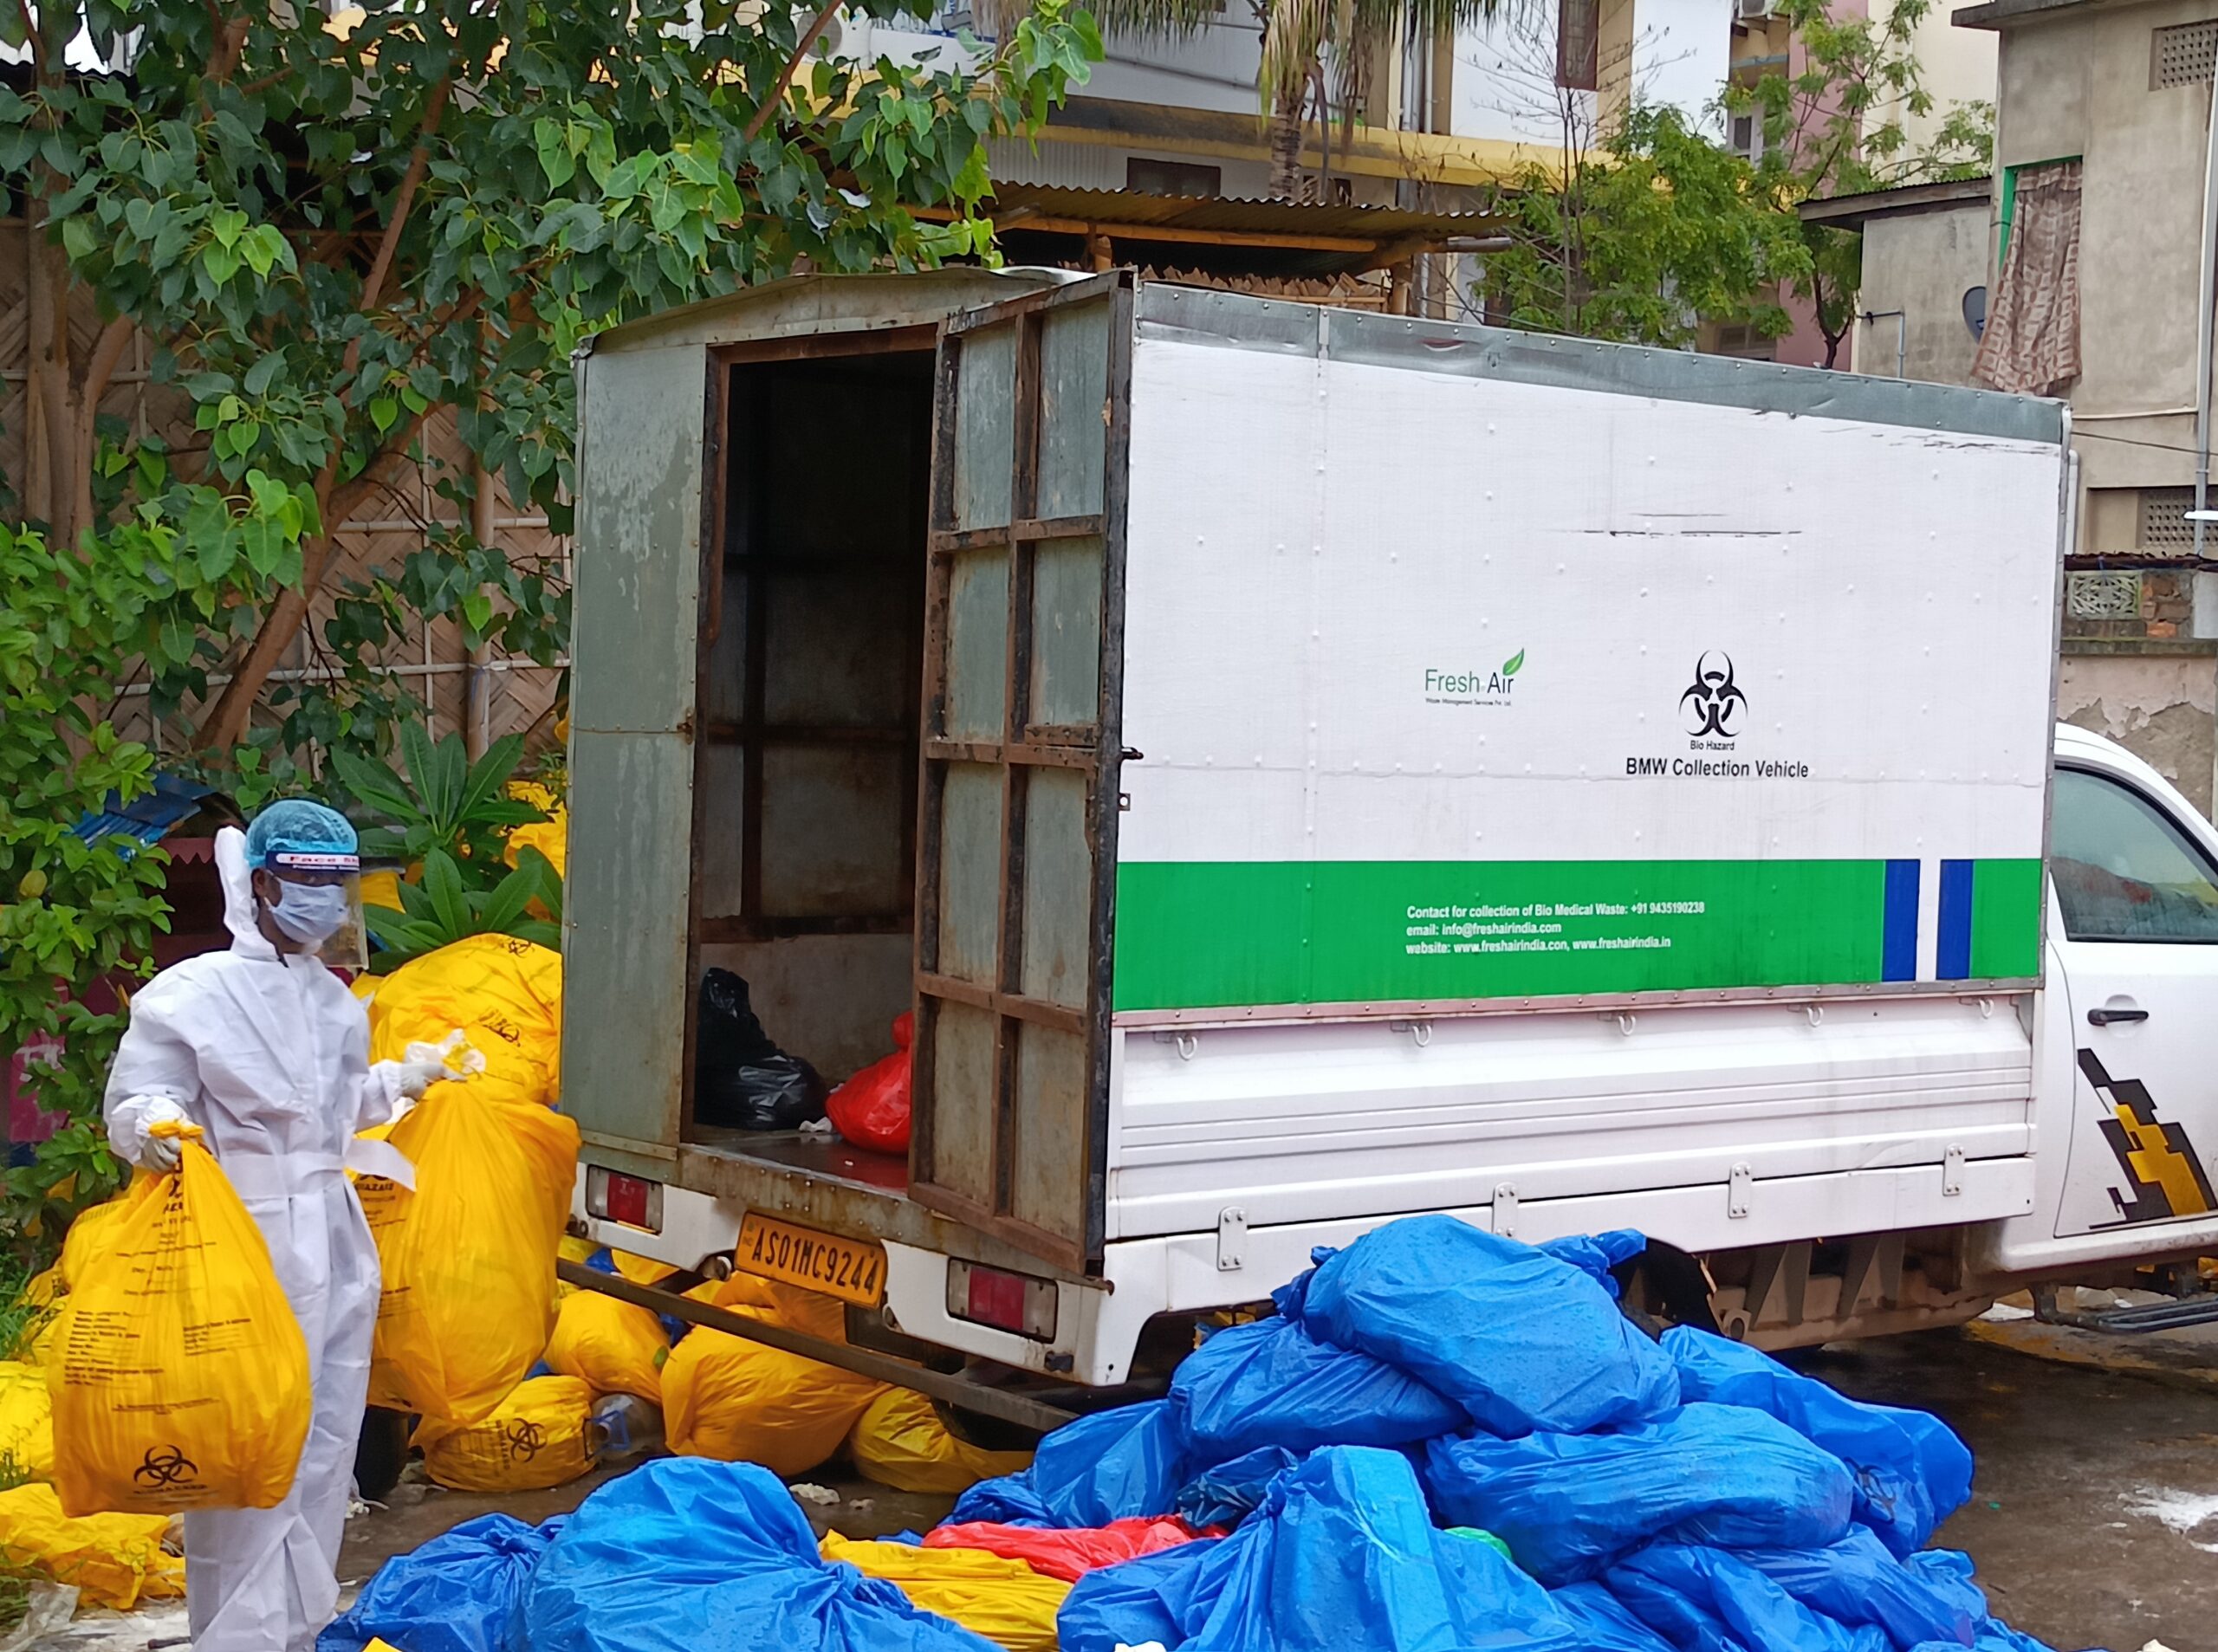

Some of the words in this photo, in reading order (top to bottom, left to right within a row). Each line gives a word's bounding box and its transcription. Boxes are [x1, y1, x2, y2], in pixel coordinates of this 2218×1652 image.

[1425, 669, 1480, 693] Fresh
[1487, 671, 1514, 694] Air
[1690, 740, 1703, 750] Bio
[1706, 740, 1735, 751] Hazard
[1626, 757, 1667, 774] BMW
[1672, 758, 1749, 777] Collection
[1755, 760, 1809, 778] Vehicle
[1407, 905, 1449, 918] Contact
[1451, 904, 1467, 917] for
[1469, 904, 1520, 917] collection
[1522, 904, 1533, 917] of
[1535, 904, 1553, 917] Bio
[1555, 903, 1593, 916] Medical
[1595, 903, 1628, 915] Waste:
[1631, 902, 1647, 914] +91
[1650, 901, 1705, 914] 9435190238
[1406, 923, 1439, 936] email:
[1442, 922, 1562, 938] info@freshairindia.com
[1406, 941, 1451, 955] website:
[1573, 936, 1671, 950] www.freshairindia.in
